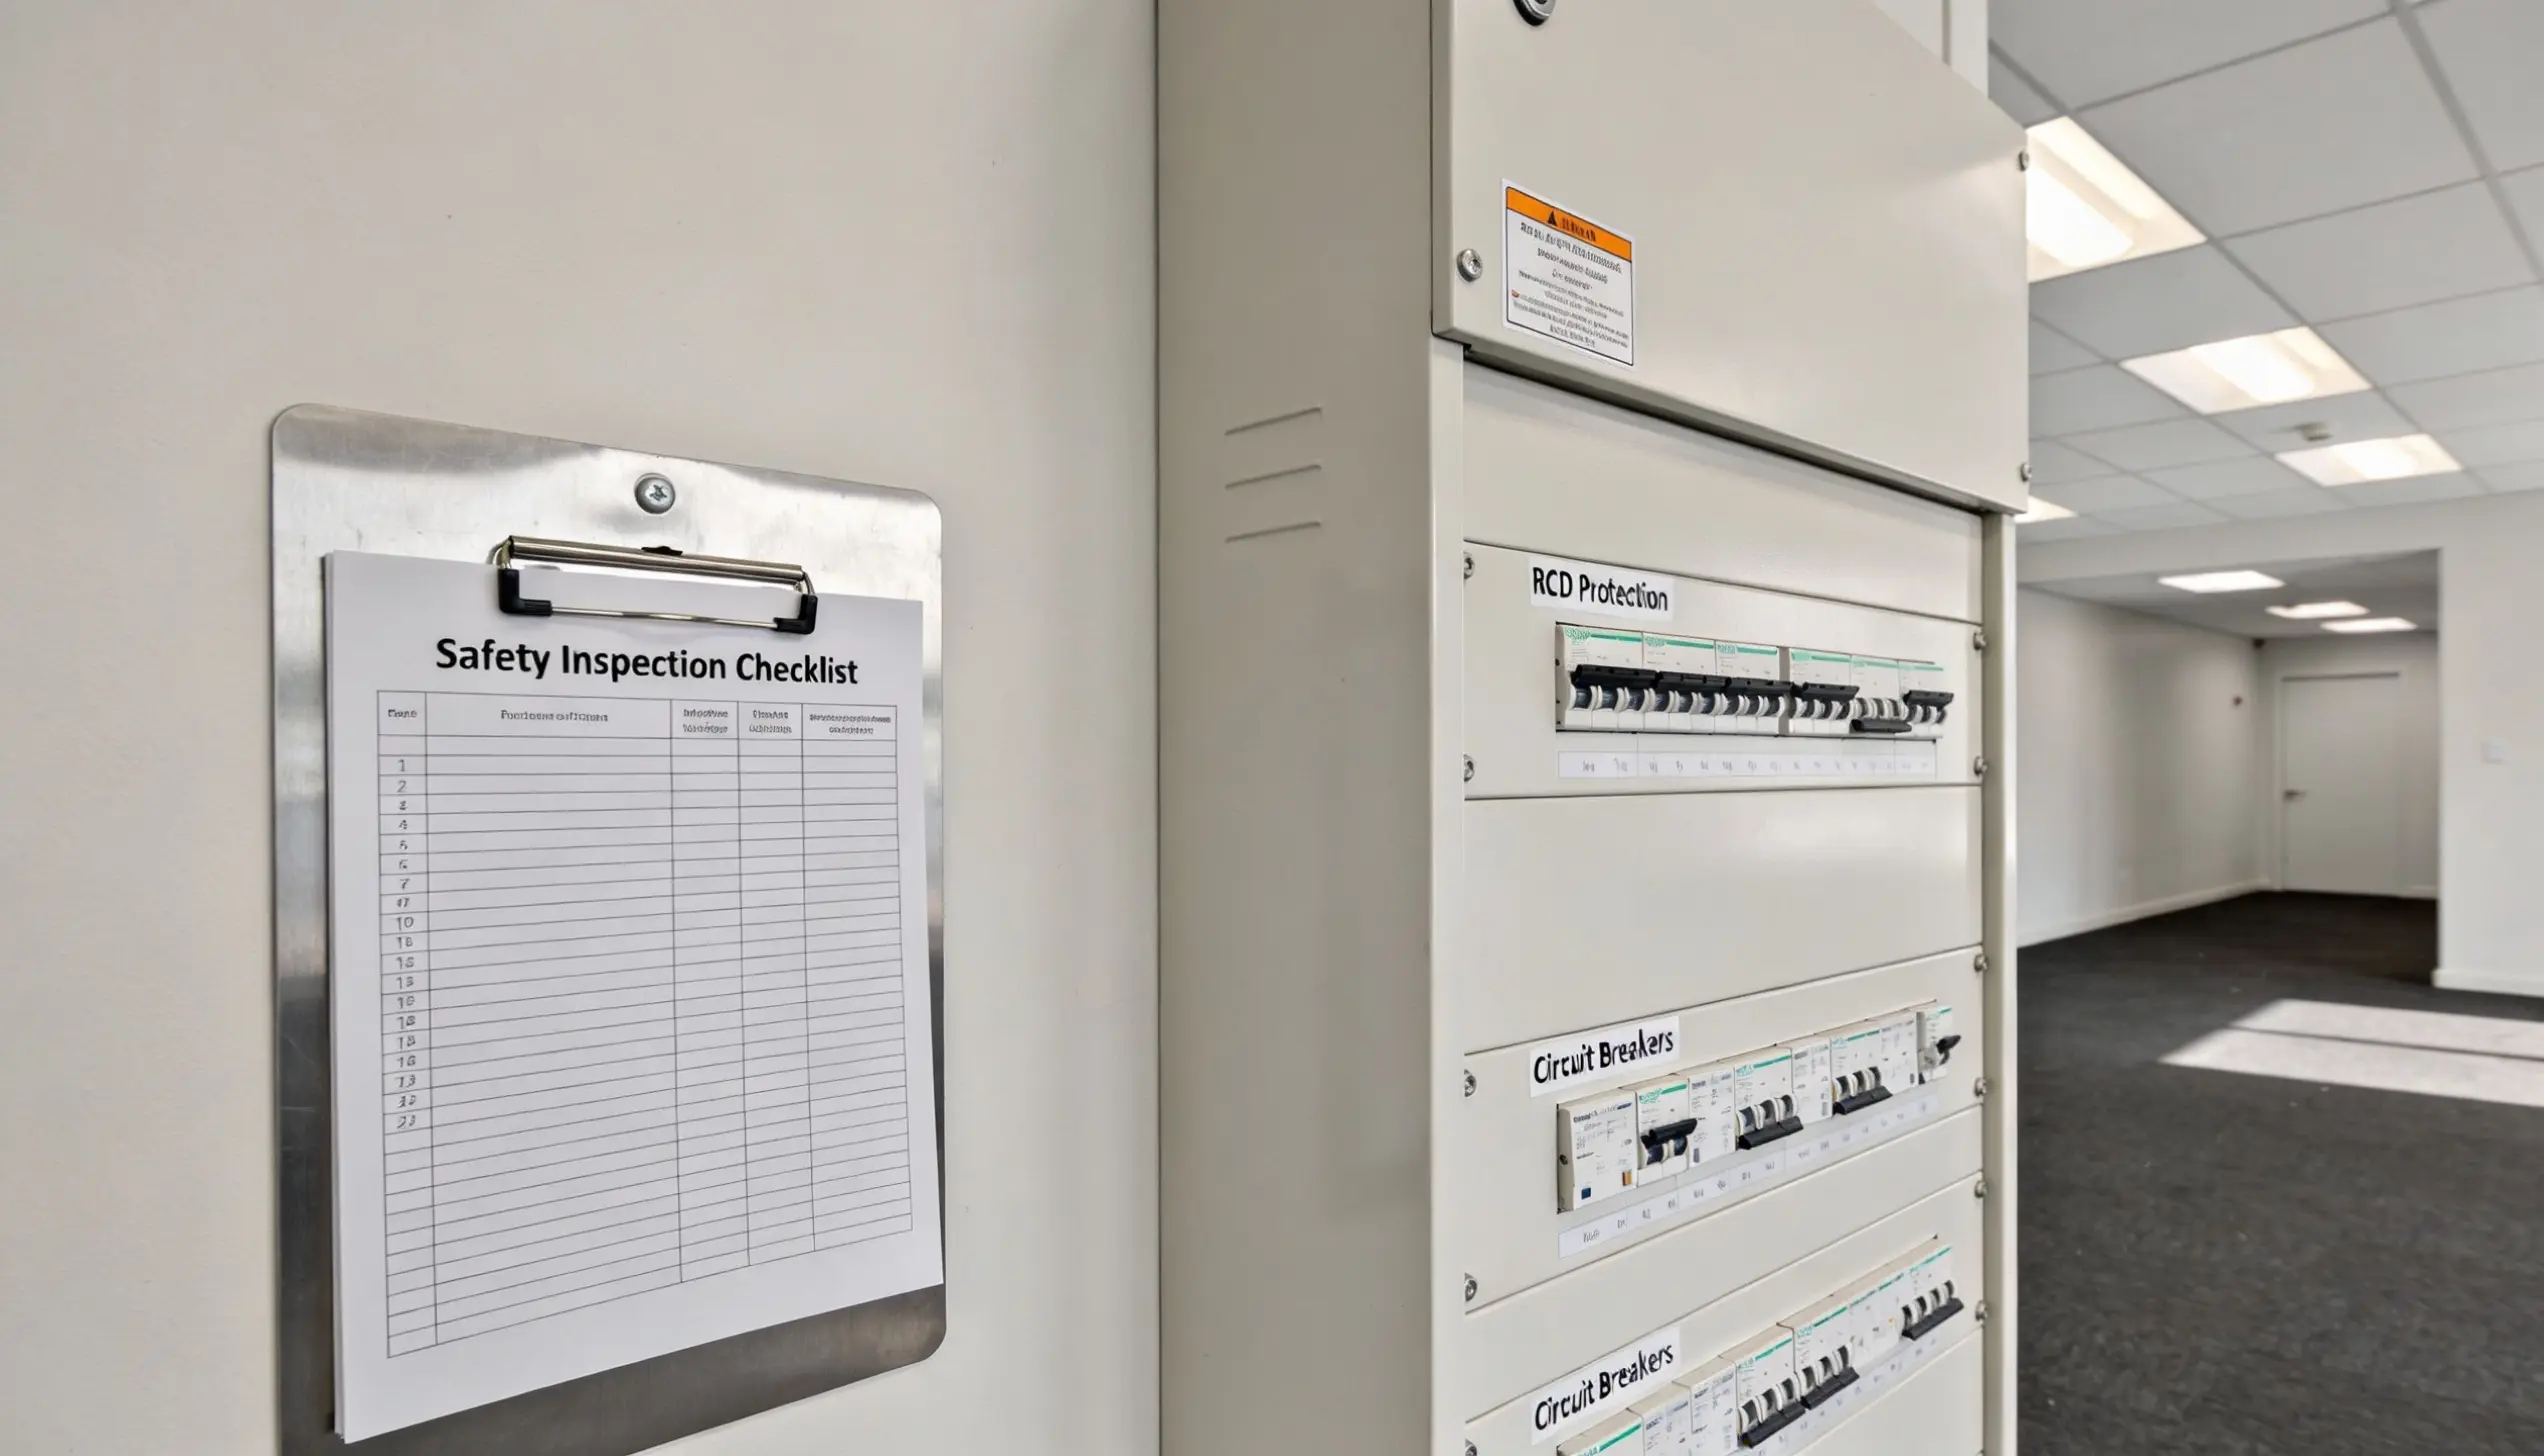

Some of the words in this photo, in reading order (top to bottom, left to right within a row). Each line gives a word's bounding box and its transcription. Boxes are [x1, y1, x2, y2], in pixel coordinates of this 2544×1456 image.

[1532, 566, 1573, 598] RCD
[1579, 573, 1669, 612] Protection
[436, 637, 551, 681] Safety
[562, 644, 726, 684] Inspection
[736, 652, 859, 685] Checklist
[397, 758, 406, 772] 1
[397, 779, 407, 793] 2
[1533, 1043, 1595, 1084] Circuit
[1599, 1029, 1674, 1068] Breakers
[1535, 1379, 1595, 1431] Circuit
[1599, 1343, 1674, 1400] Breakers
